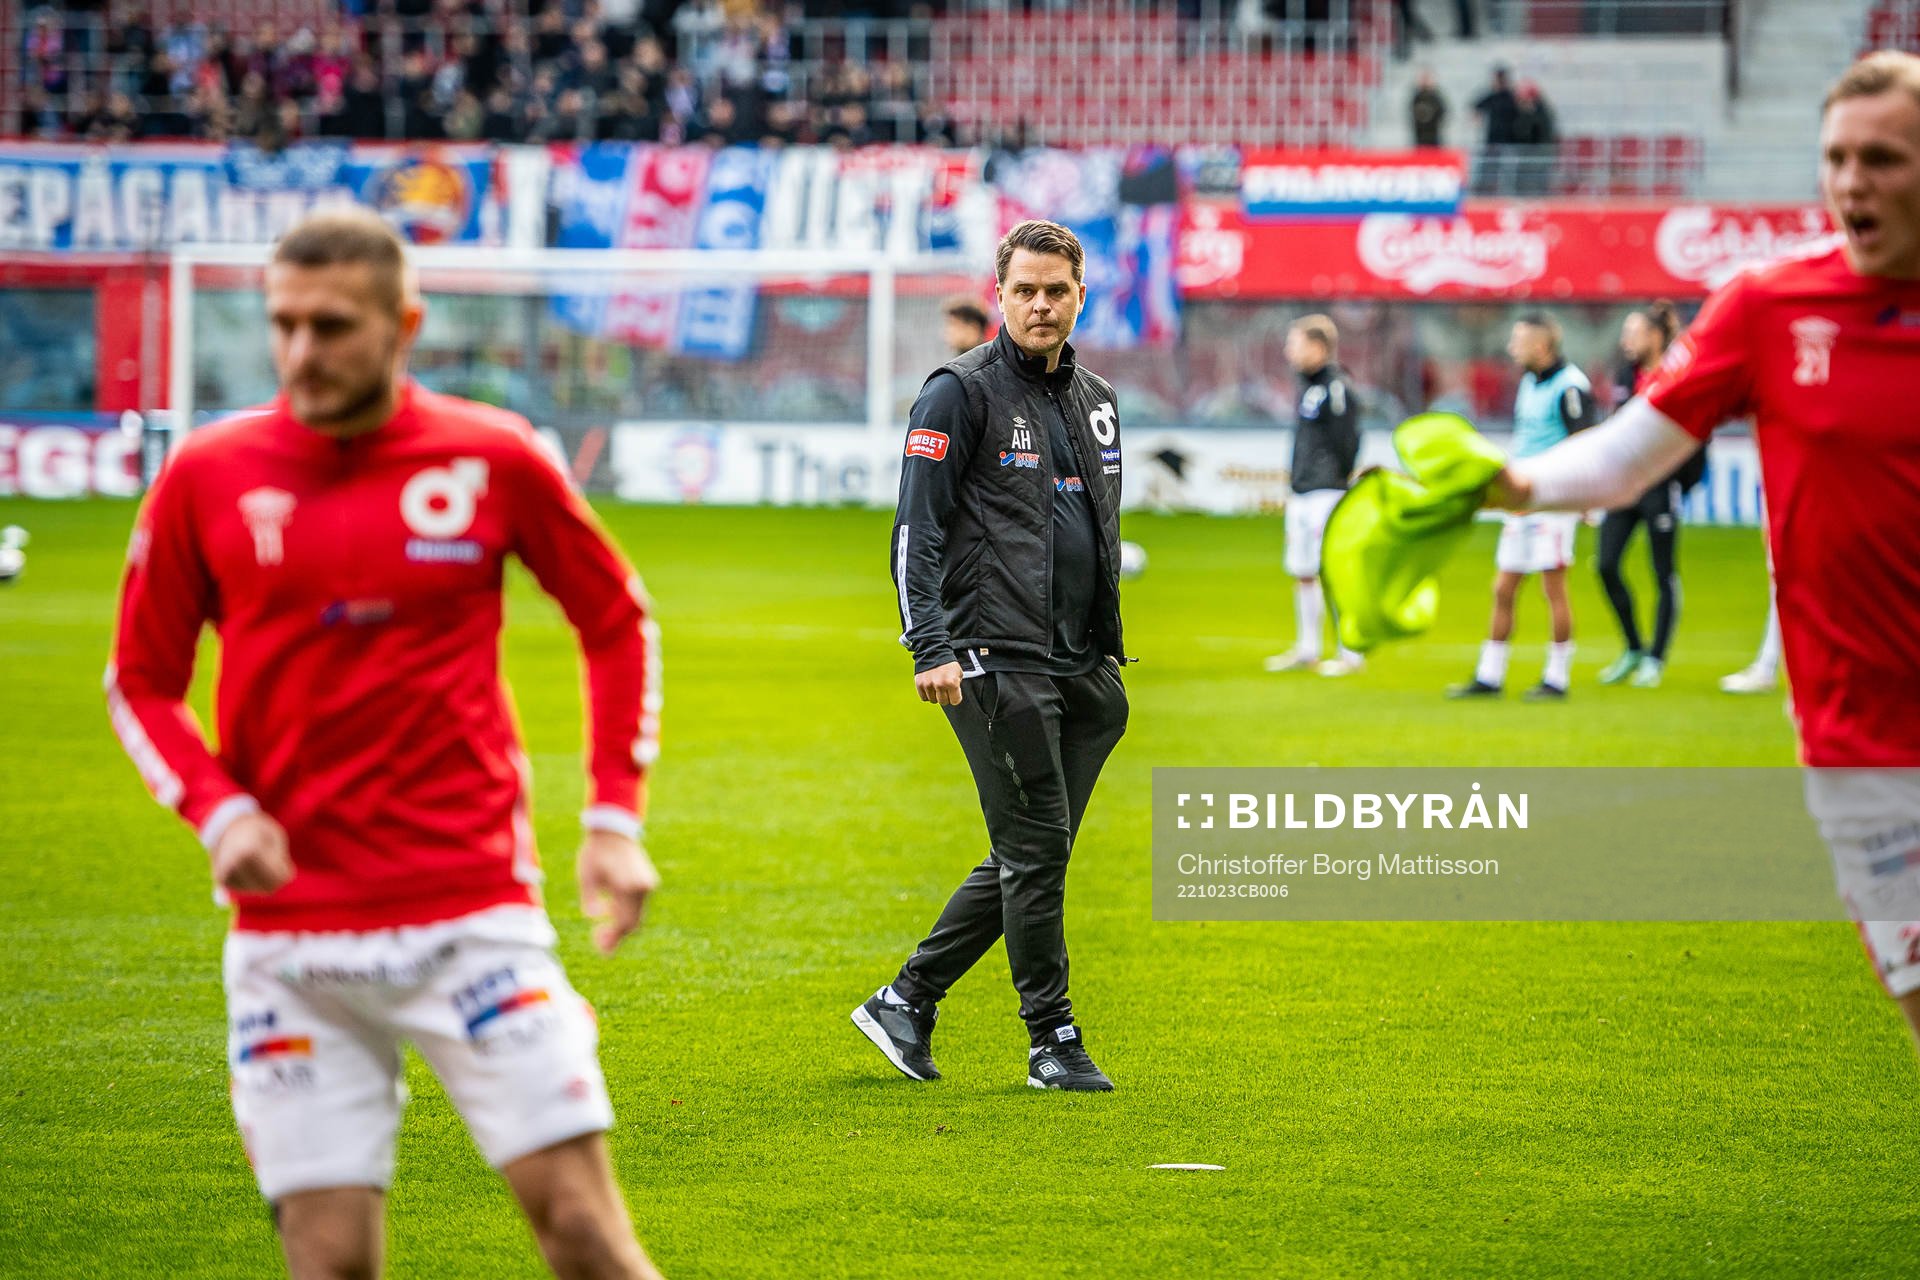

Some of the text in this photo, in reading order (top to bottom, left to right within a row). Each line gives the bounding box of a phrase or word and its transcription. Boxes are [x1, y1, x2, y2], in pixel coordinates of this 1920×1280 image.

[909, 434, 946, 450] UNIBET
[1011, 428, 1032, 450] AH
[1015, 452, 1040, 461] INTER
[1015, 460, 1039, 469] SPORT
